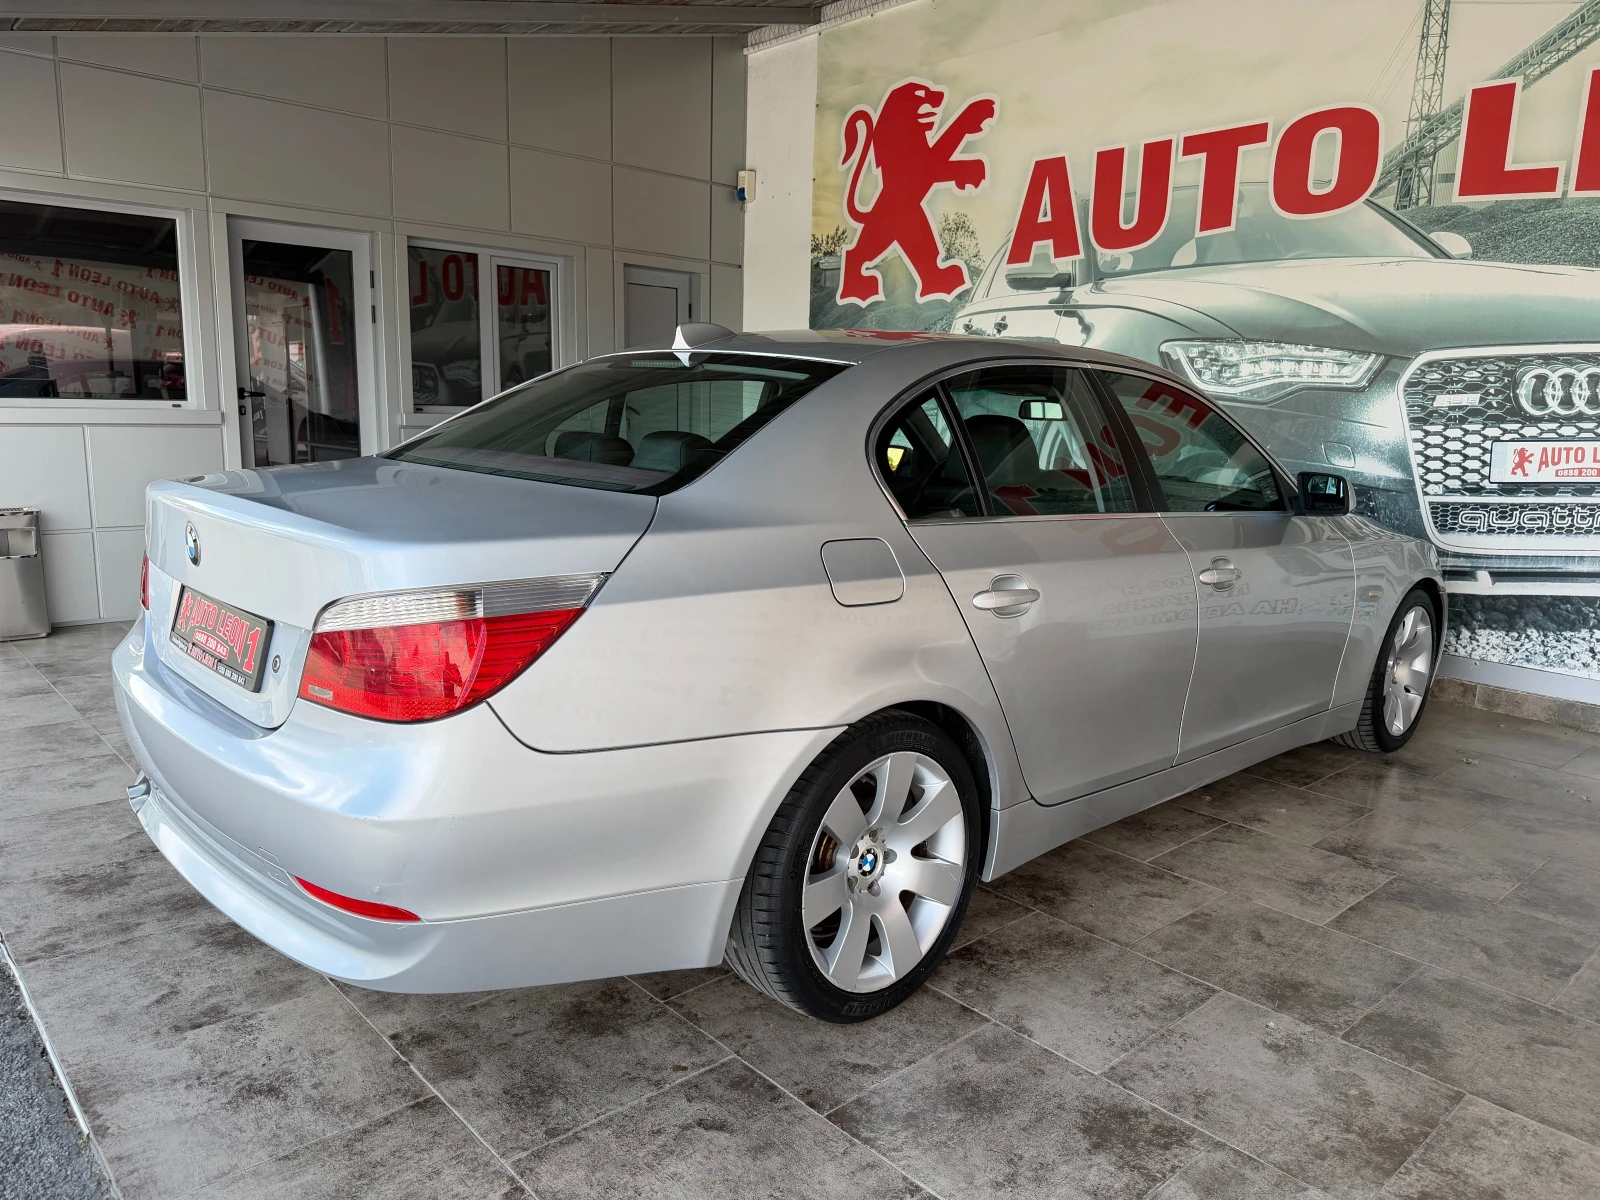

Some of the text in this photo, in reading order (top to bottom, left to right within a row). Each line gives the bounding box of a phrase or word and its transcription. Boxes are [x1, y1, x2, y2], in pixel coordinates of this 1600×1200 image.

[1005, 104, 1381, 267] AUTO
[1537, 446, 1586, 474] AUTO
[1581, 468, 1598, 477] 200
[186, 596, 262, 674] AUTO LEON 1
